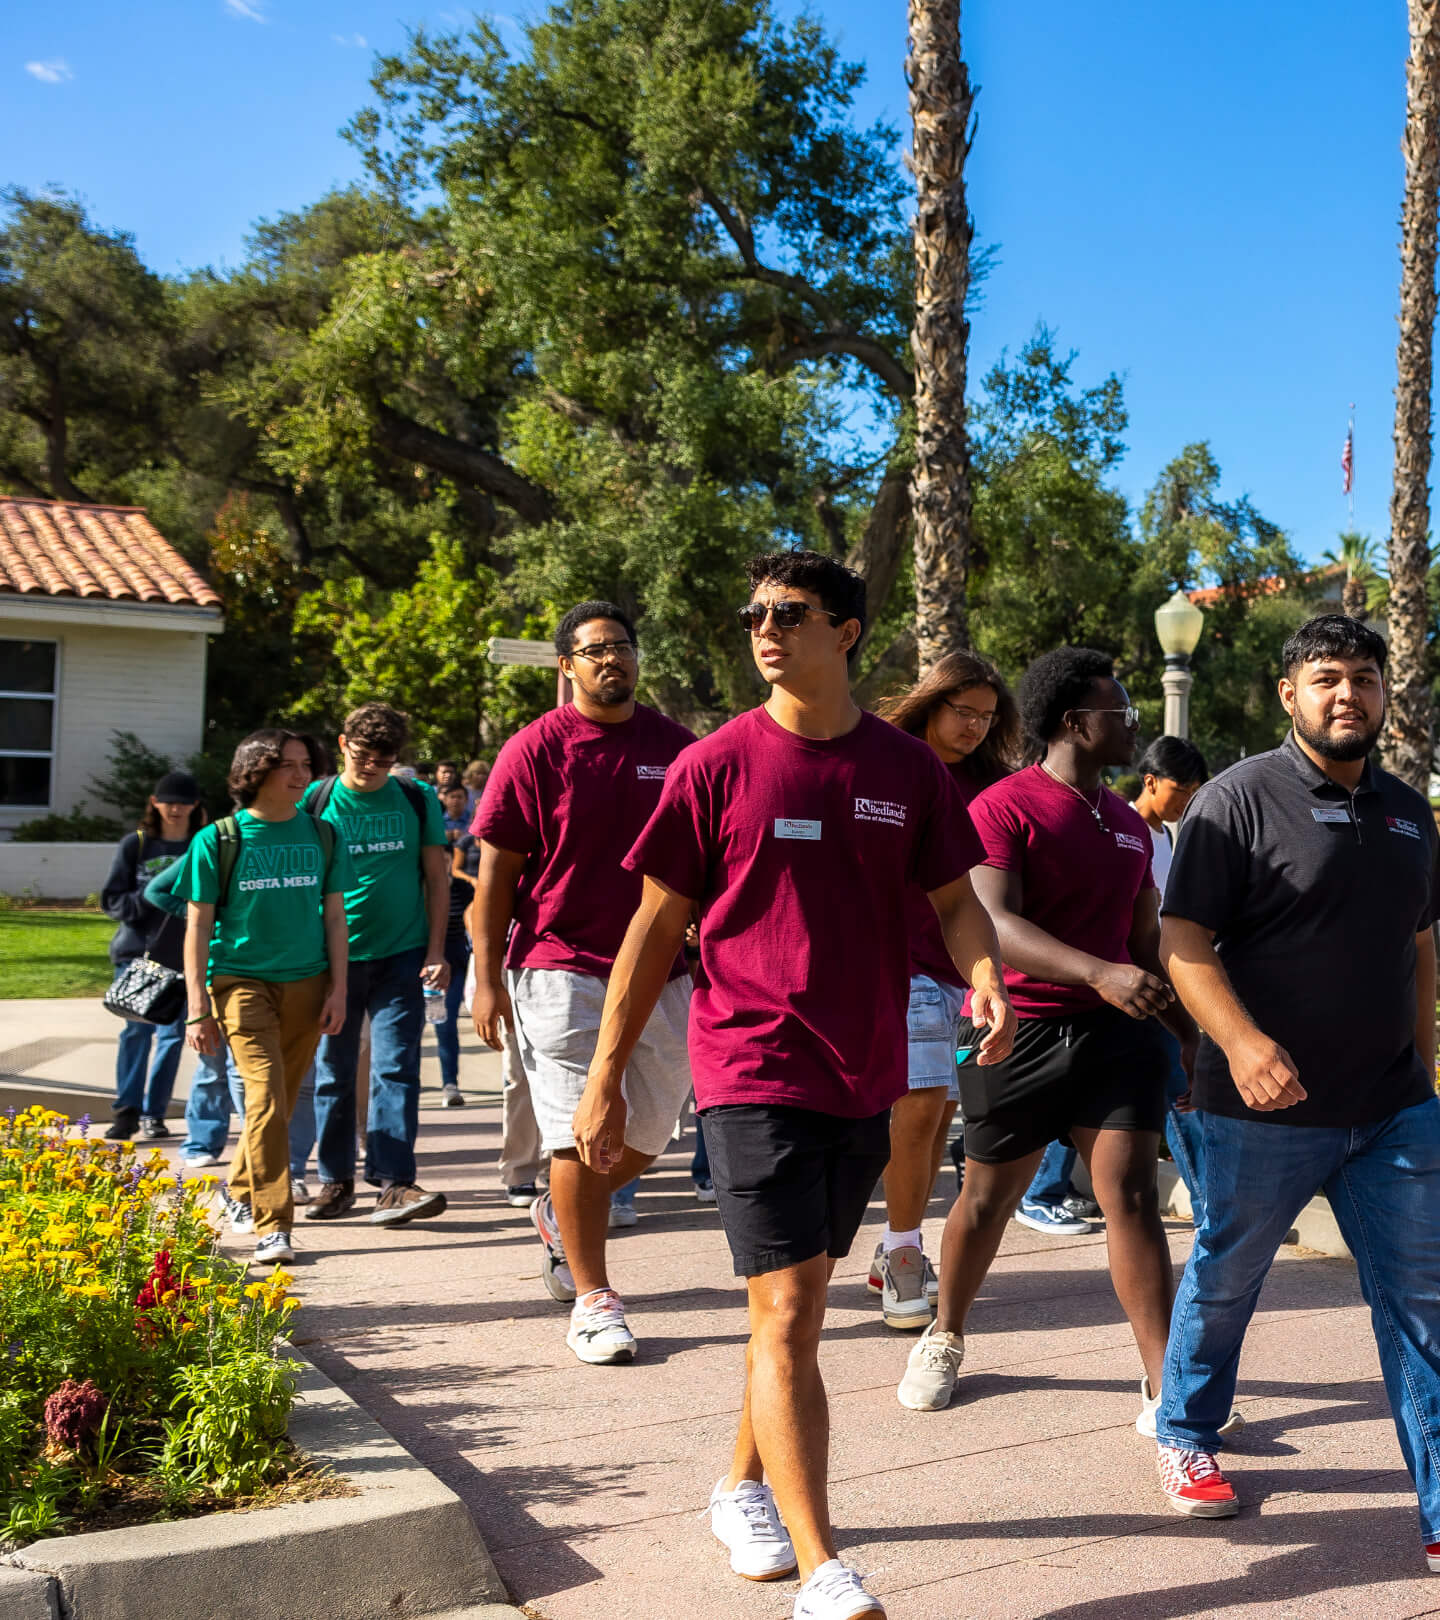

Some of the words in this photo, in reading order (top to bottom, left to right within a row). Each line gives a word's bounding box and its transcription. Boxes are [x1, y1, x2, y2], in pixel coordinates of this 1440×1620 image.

[854, 813, 871, 821] Office
[870, 804, 906, 820] Redlands
[367, 840, 405, 853] MESA
[238, 845, 320, 880] AVID
[239, 878, 281, 891] COSTA
